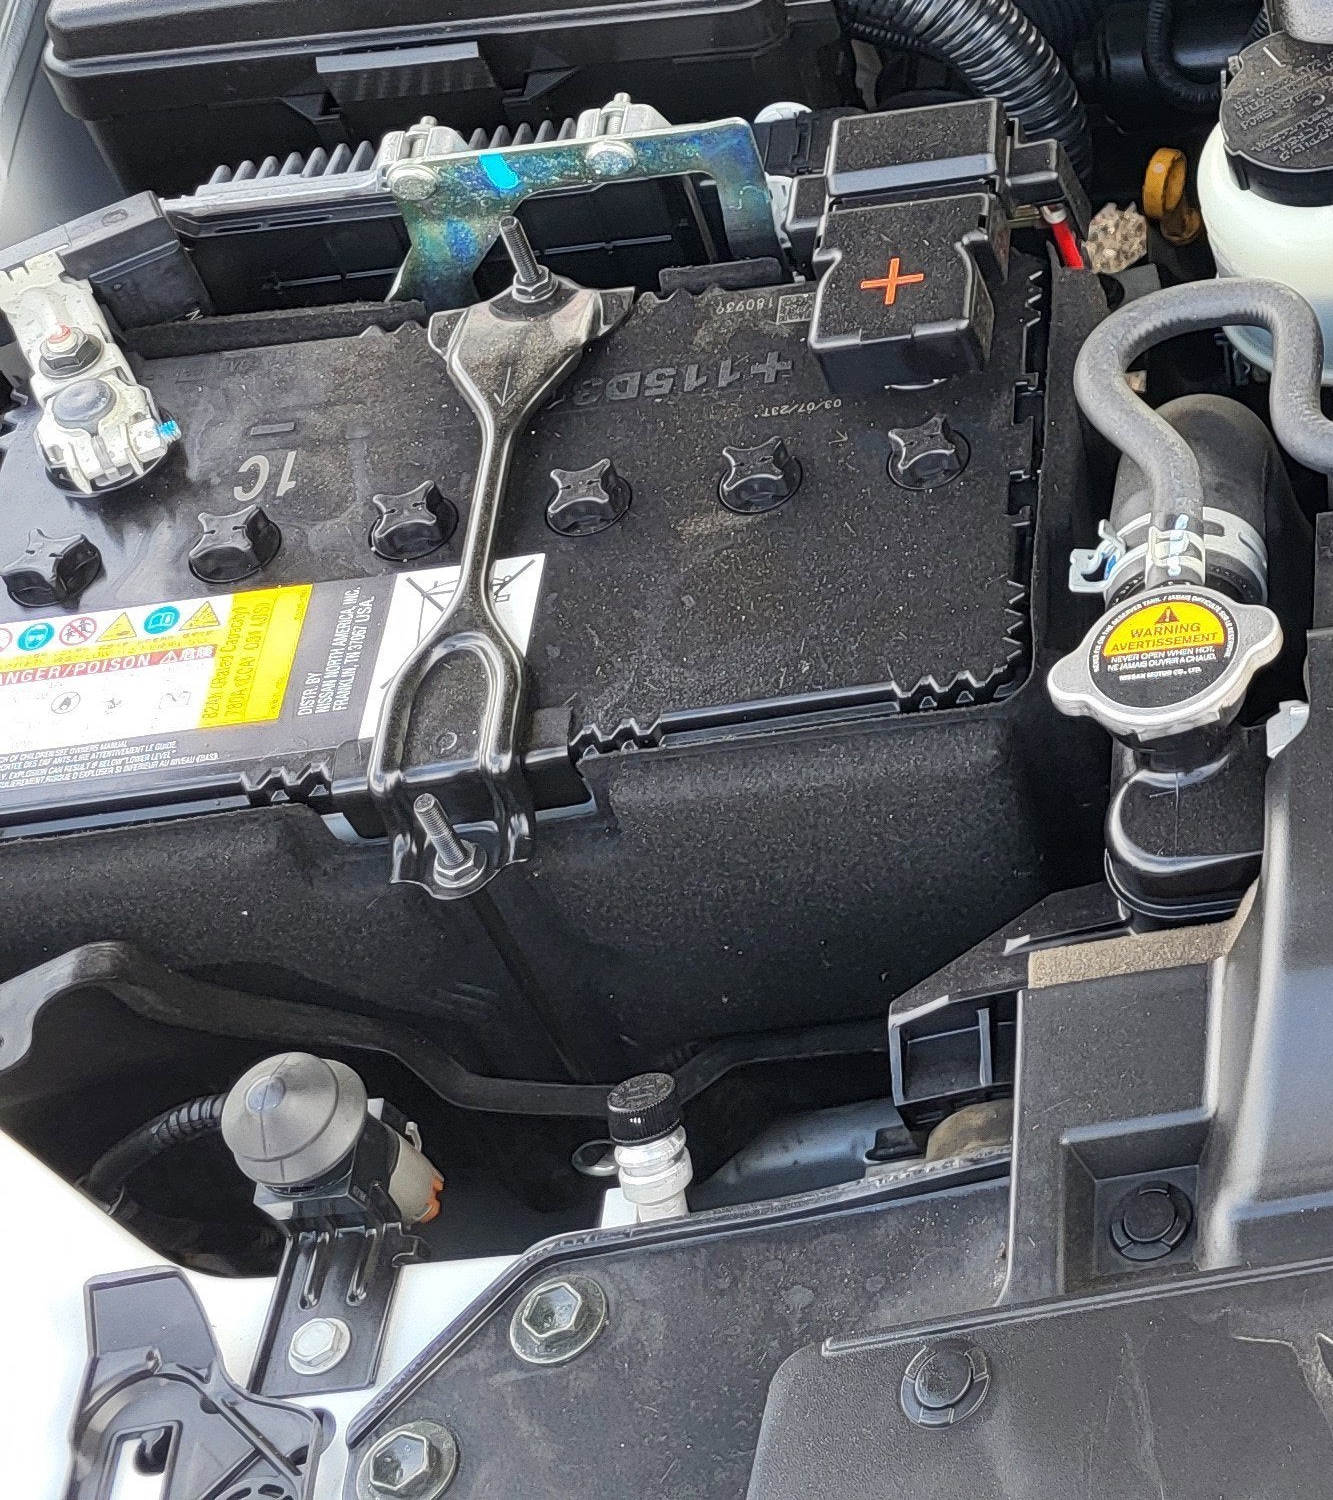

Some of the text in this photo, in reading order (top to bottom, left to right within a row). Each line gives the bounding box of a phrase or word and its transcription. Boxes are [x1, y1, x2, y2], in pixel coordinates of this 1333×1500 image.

[234, 450, 297, 501] 1C
[348, 624, 367, 650] 37067
[1111, 632, 1218, 652] AVERTISSEMENT
[1131, 623, 1201, 638] WARNING
[315, 587, 360, 713] NISSAN NORTH AMERICA, INC.
[345, 651, 361, 664] TN
[1111, 654, 1139, 663] NEVER
[1141, 651, 1165, 660] OPEN
[1167, 647, 1193, 657] WHEN
[0, 655, 150, 685] NGER/POISON
[297, 672, 322, 715] DISTR. BY
[333, 665, 359, 711] FRANKLIN,
